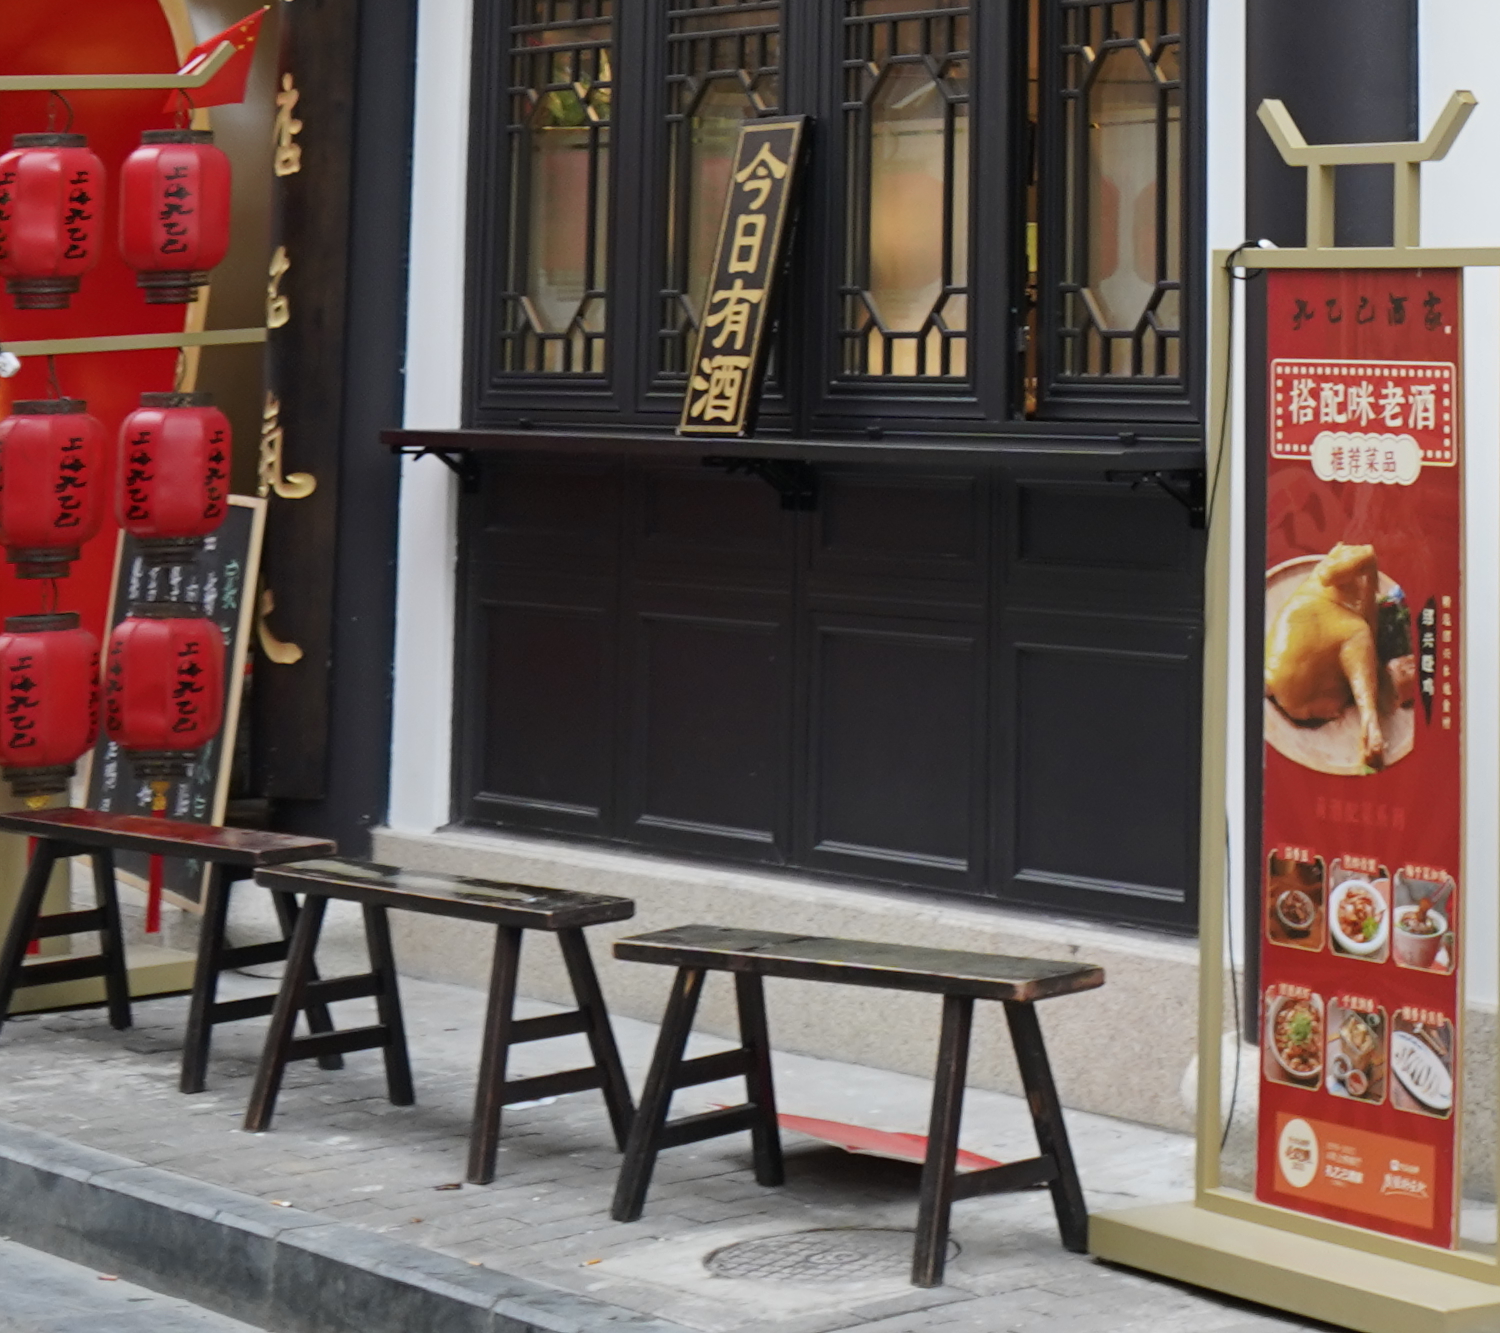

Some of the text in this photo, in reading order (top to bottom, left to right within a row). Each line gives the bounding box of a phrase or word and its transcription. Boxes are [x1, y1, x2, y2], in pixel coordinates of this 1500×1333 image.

[64, 170, 91, 262] 上海孔乙己
[159, 165, 191, 255] 上海孔乙己
[690, 141, 788, 423] 今日有酒
[1293, 289, 1443, 331] 孔乙己酒家
[1289, 378, 1437, 430] 搭配咪老酒
[54, 437, 84, 529] 上海孔乙己
[126, 430, 152, 521] 上海孔乙己
[1330, 446, 1397, 474] 推荐菜品
[8, 655, 37, 749] 上海孔乙己
[172, 642, 203, 734] 上海孔乙己
